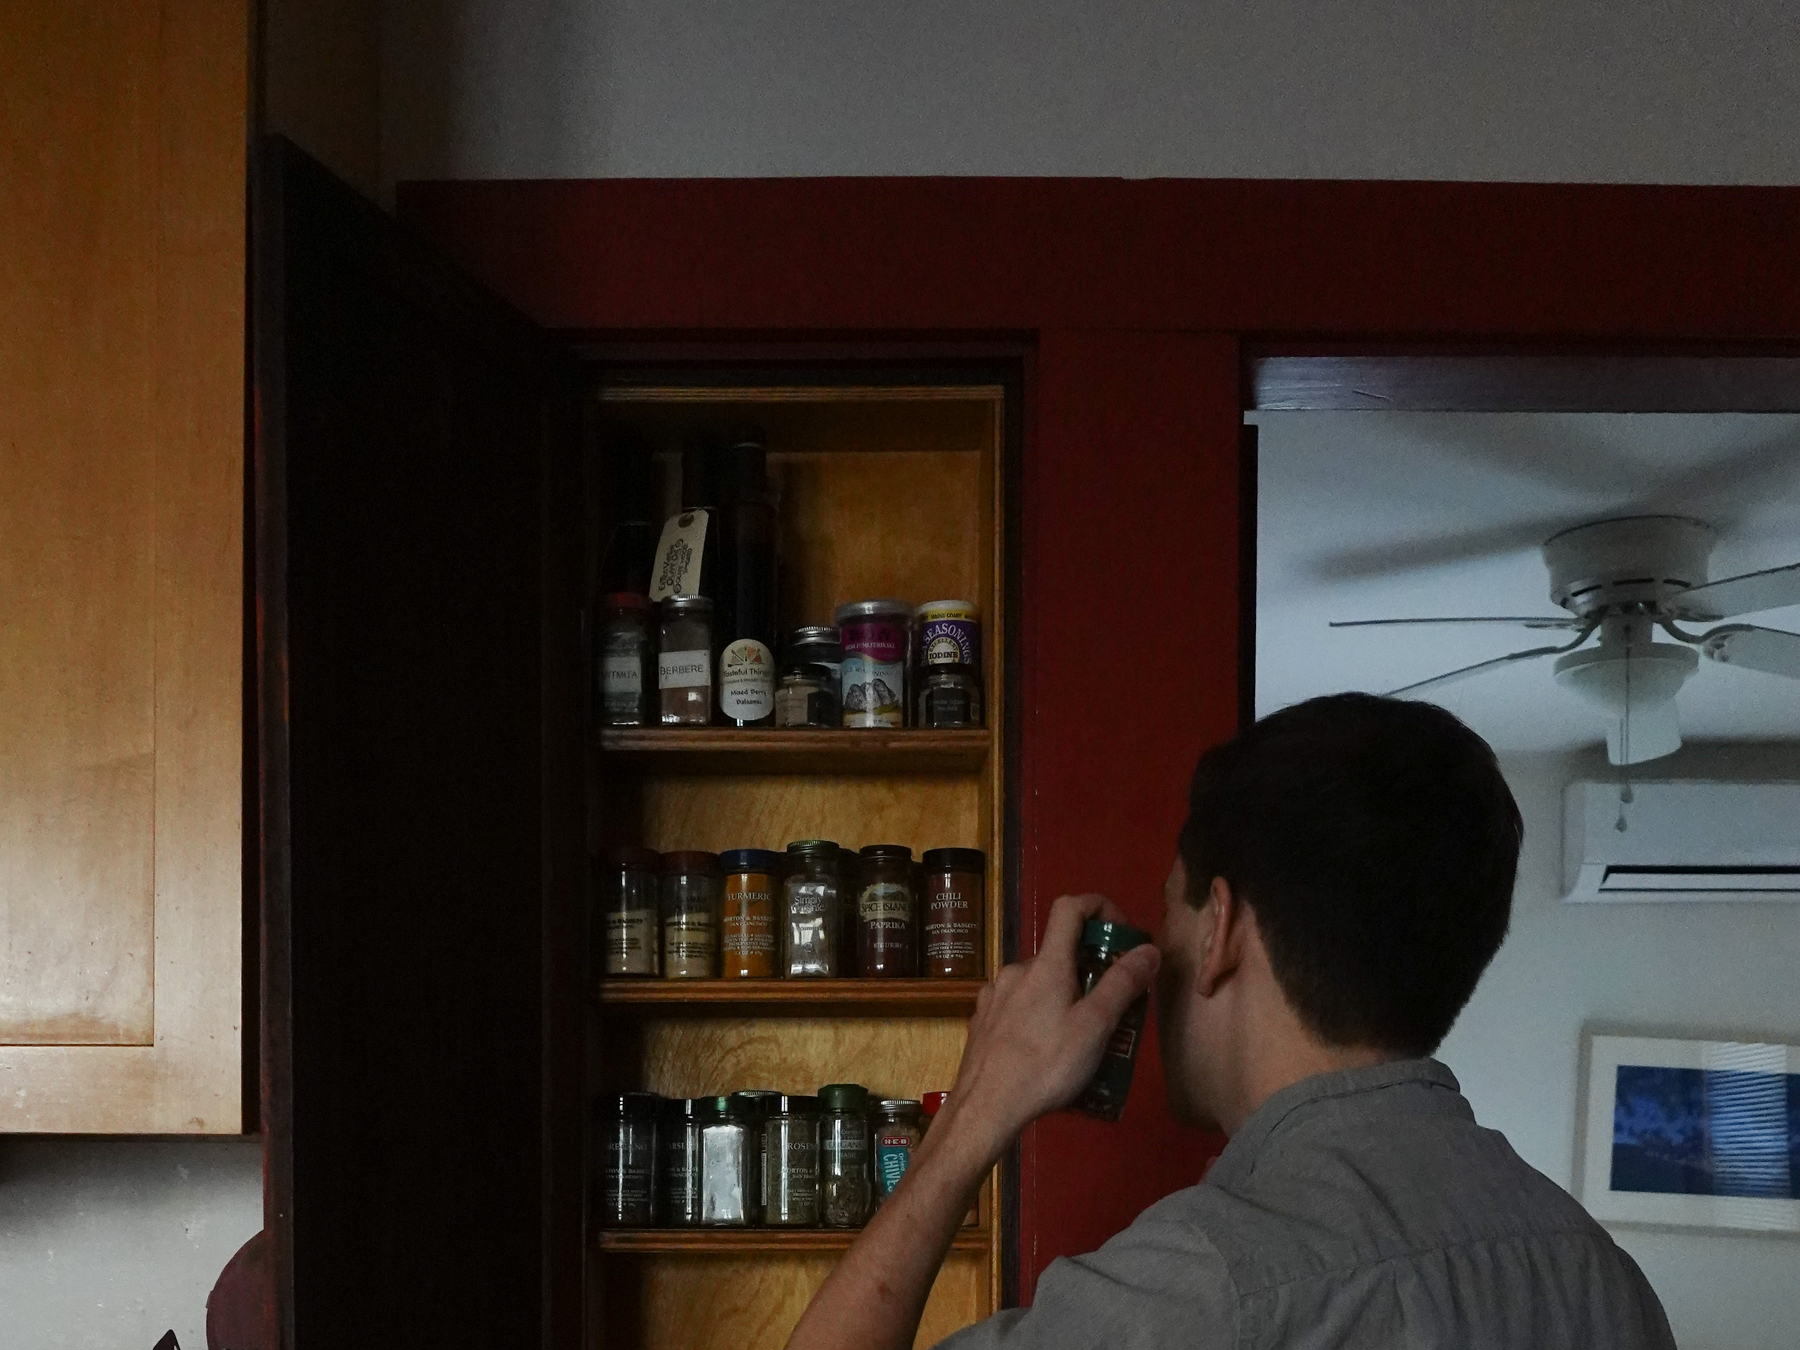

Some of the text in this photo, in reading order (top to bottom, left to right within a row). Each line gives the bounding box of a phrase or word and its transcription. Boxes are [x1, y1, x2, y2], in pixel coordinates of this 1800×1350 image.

[923, 622, 972, 665] SEASONINGS
[929, 651, 959, 660] IODINE
[660, 664, 704, 676] BERBERE
[727, 891, 772, 901] TURMERIC
[935, 892, 962, 901] CHILI
[861, 902, 909, 913] SPICE ISLAN
[930, 900, 969, 910] POWDER
[870, 921, 906, 930] PAPRIKA
